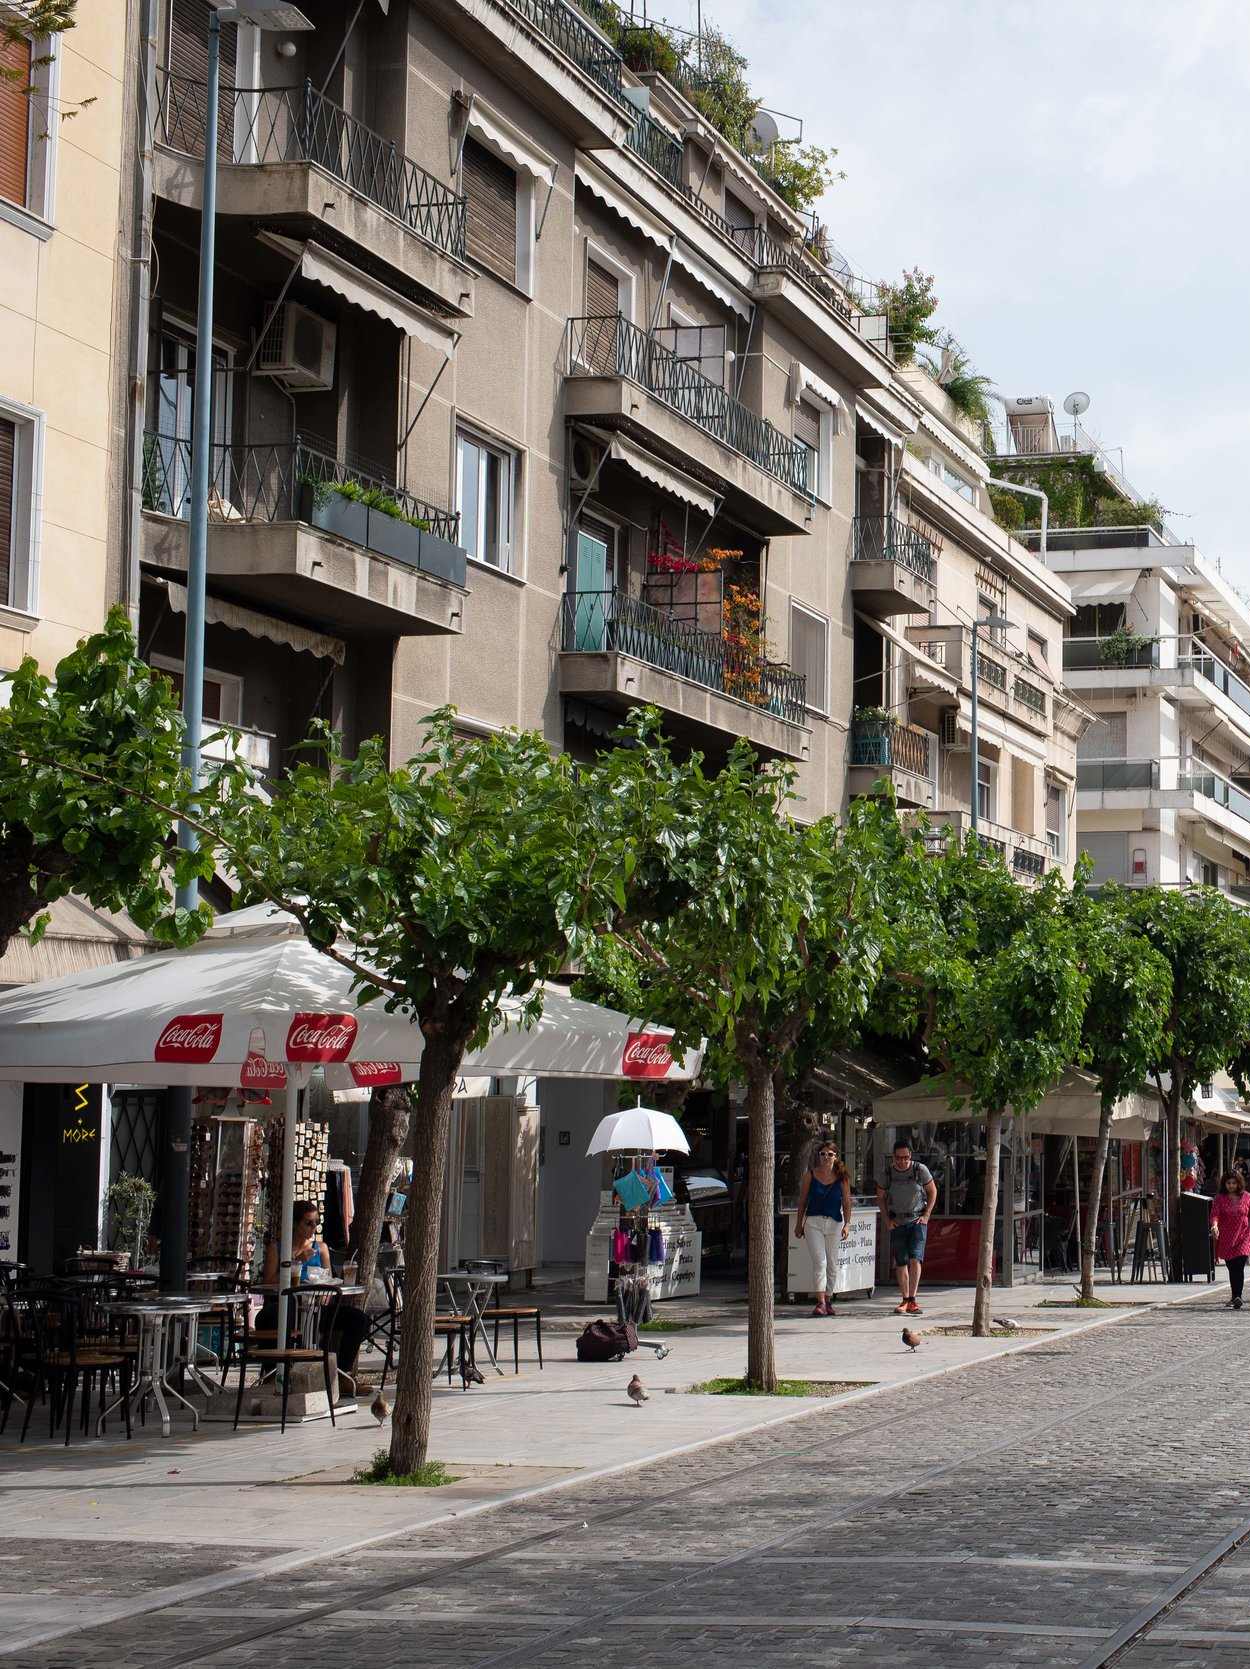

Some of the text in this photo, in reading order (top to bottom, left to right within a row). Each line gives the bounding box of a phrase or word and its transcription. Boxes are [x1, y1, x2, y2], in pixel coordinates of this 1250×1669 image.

[160, 1023, 220, 1048] Coca-Cola
[290, 1024, 356, 1049] Coca-Cola
[62, 1128, 96, 1144] MORE
[858, 1221, 871, 1231] Silver
[839, 1240, 856, 1252] rgento
[861, 1237, 872, 1247] Plata
[836, 1256, 850, 1268] rgent
